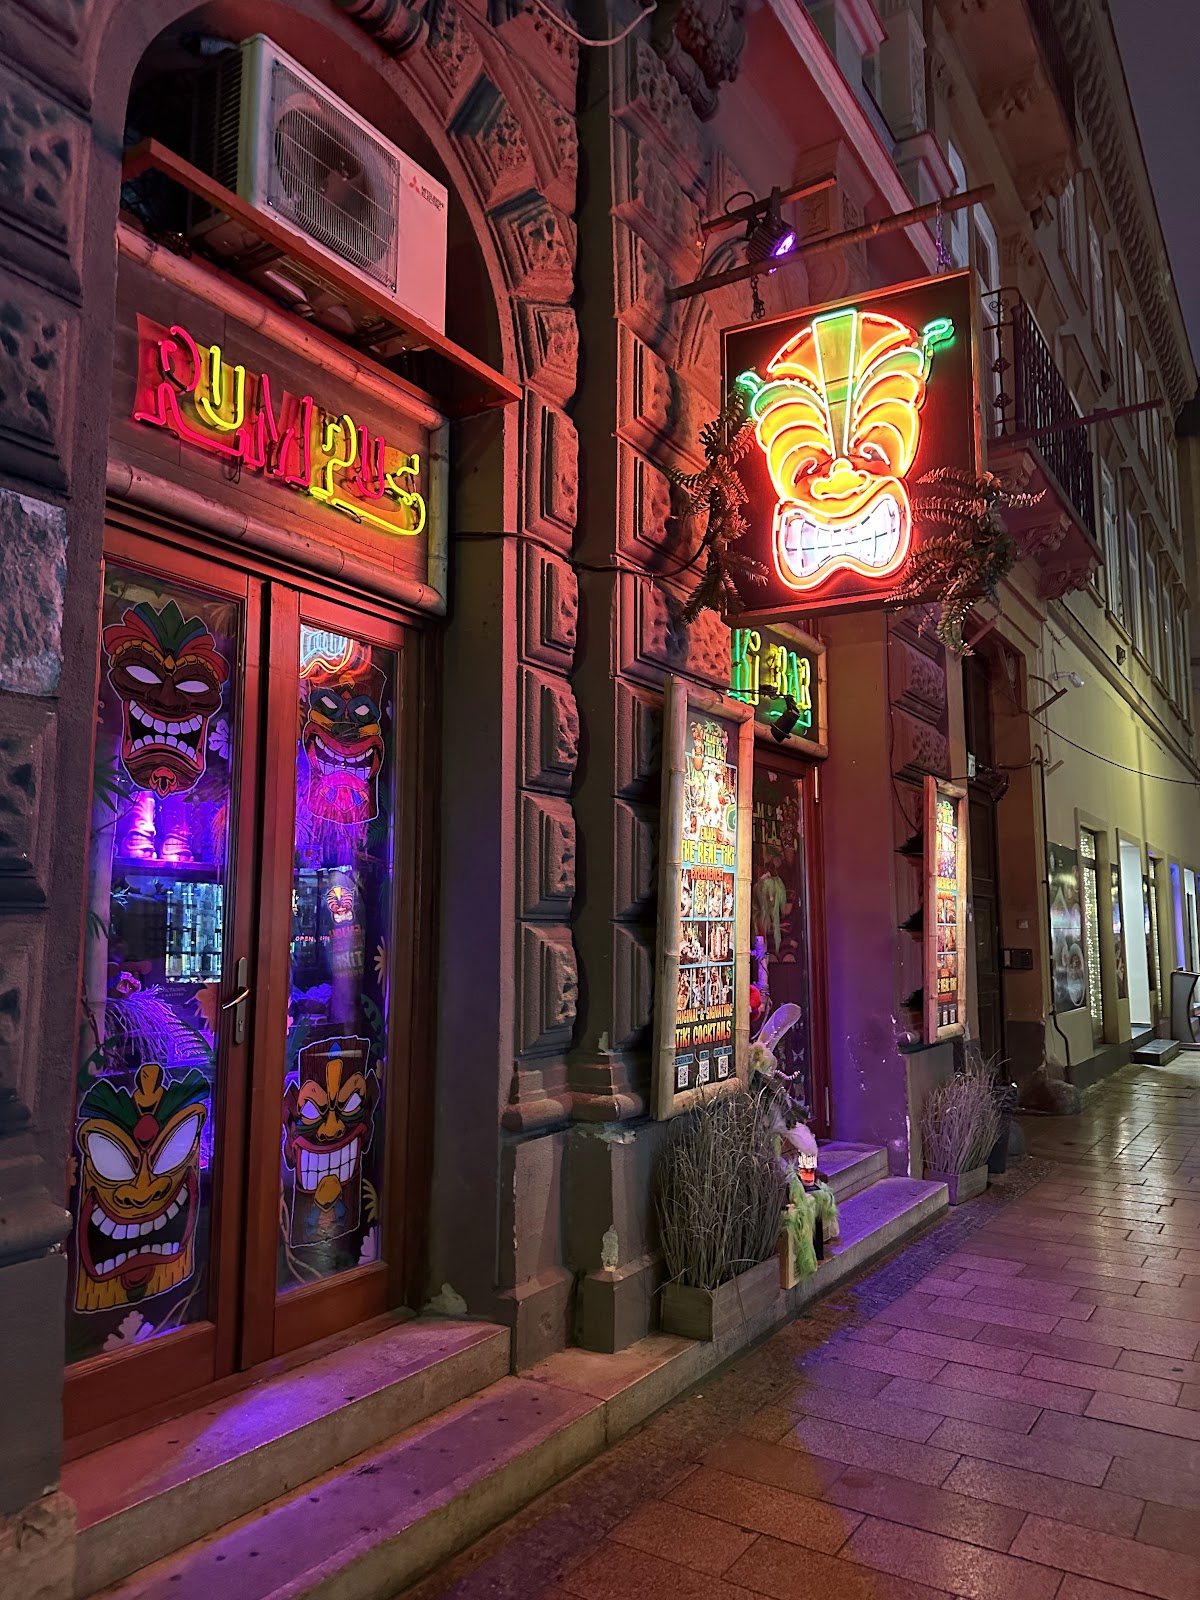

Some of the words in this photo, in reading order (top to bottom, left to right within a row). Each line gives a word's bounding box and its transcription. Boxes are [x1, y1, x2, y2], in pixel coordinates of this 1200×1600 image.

[134, 324, 427, 535] RUMPUS
[682, 839, 696, 863] THE
[697, 841, 718, 865] REAL
[675, 1008, 699, 1024] RIGINAL
[693, 1020, 732, 1046] COCKTAILS
